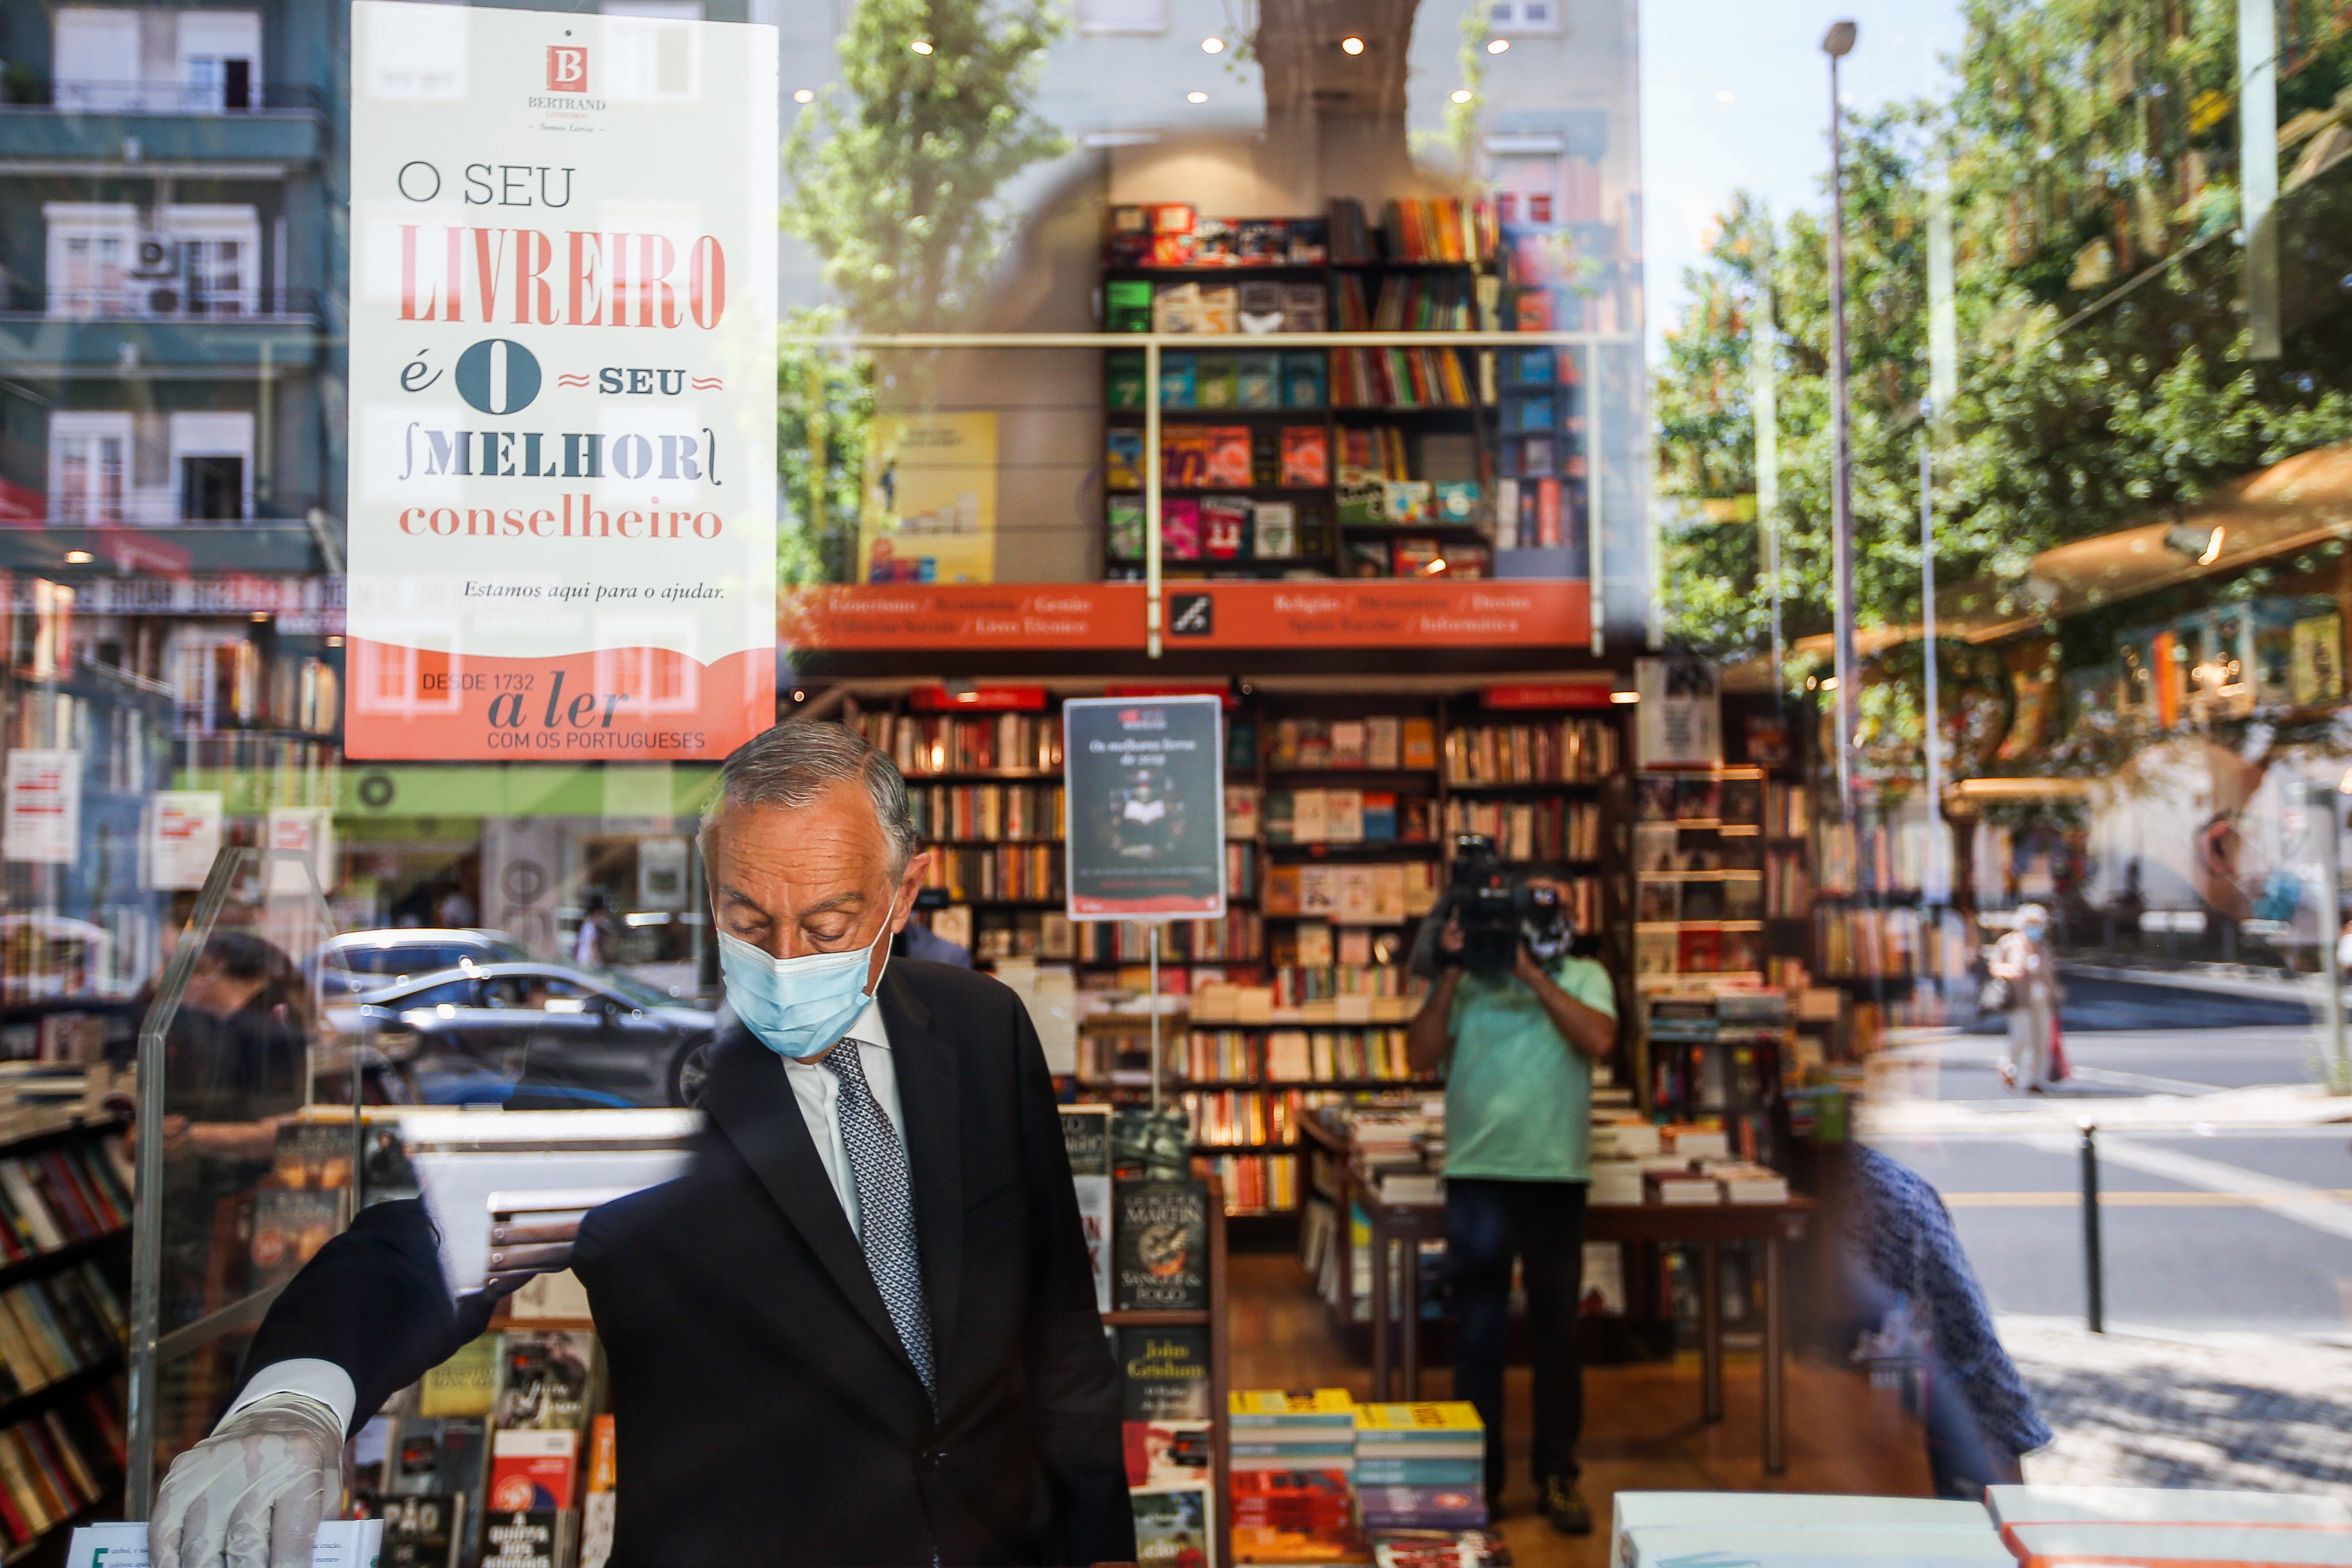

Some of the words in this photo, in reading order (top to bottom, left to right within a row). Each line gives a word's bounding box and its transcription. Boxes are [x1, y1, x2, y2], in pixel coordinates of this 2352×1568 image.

[555, 49, 583, 82] B
[528, 96, 606, 110] BERTRAND
[398, 161, 441, 202] O
[464, 163, 576, 208] SEU
[397, 224, 726, 330] LIVREIRO
[400, 348, 443, 392] é
[455, 338, 542, 415] O
[598, 367, 686, 395] SEU
[424, 430, 701, 480] MELHOR
[399, 493, 722, 539] conselheiro
[464, 580, 542, 598] Estamos
[548, 582, 590, 602] aqui
[595, 584, 637, 602] para
[644, 587, 655, 598] o
[660, 582, 725, 602] ajudar.
[975, 617, 1021, 635] Livro
[1024, 617, 1089, 635] Técnico
[1420, 615, 1519, 633] Informática
[423, 673, 487, 691] DESDE
[492, 674, 534, 691] 1732
[488, 693, 527, 728] a
[544, 671, 629, 728] ler
[488, 731, 530, 748] COM
[536, 731, 561, 748] OS
[566, 731, 705, 749] PORTUGUESES
[1144, 1339, 1190, 1360] John
[1127, 1357, 1205, 1379] Grisham
[383, 1496, 440, 1532] PÃO
